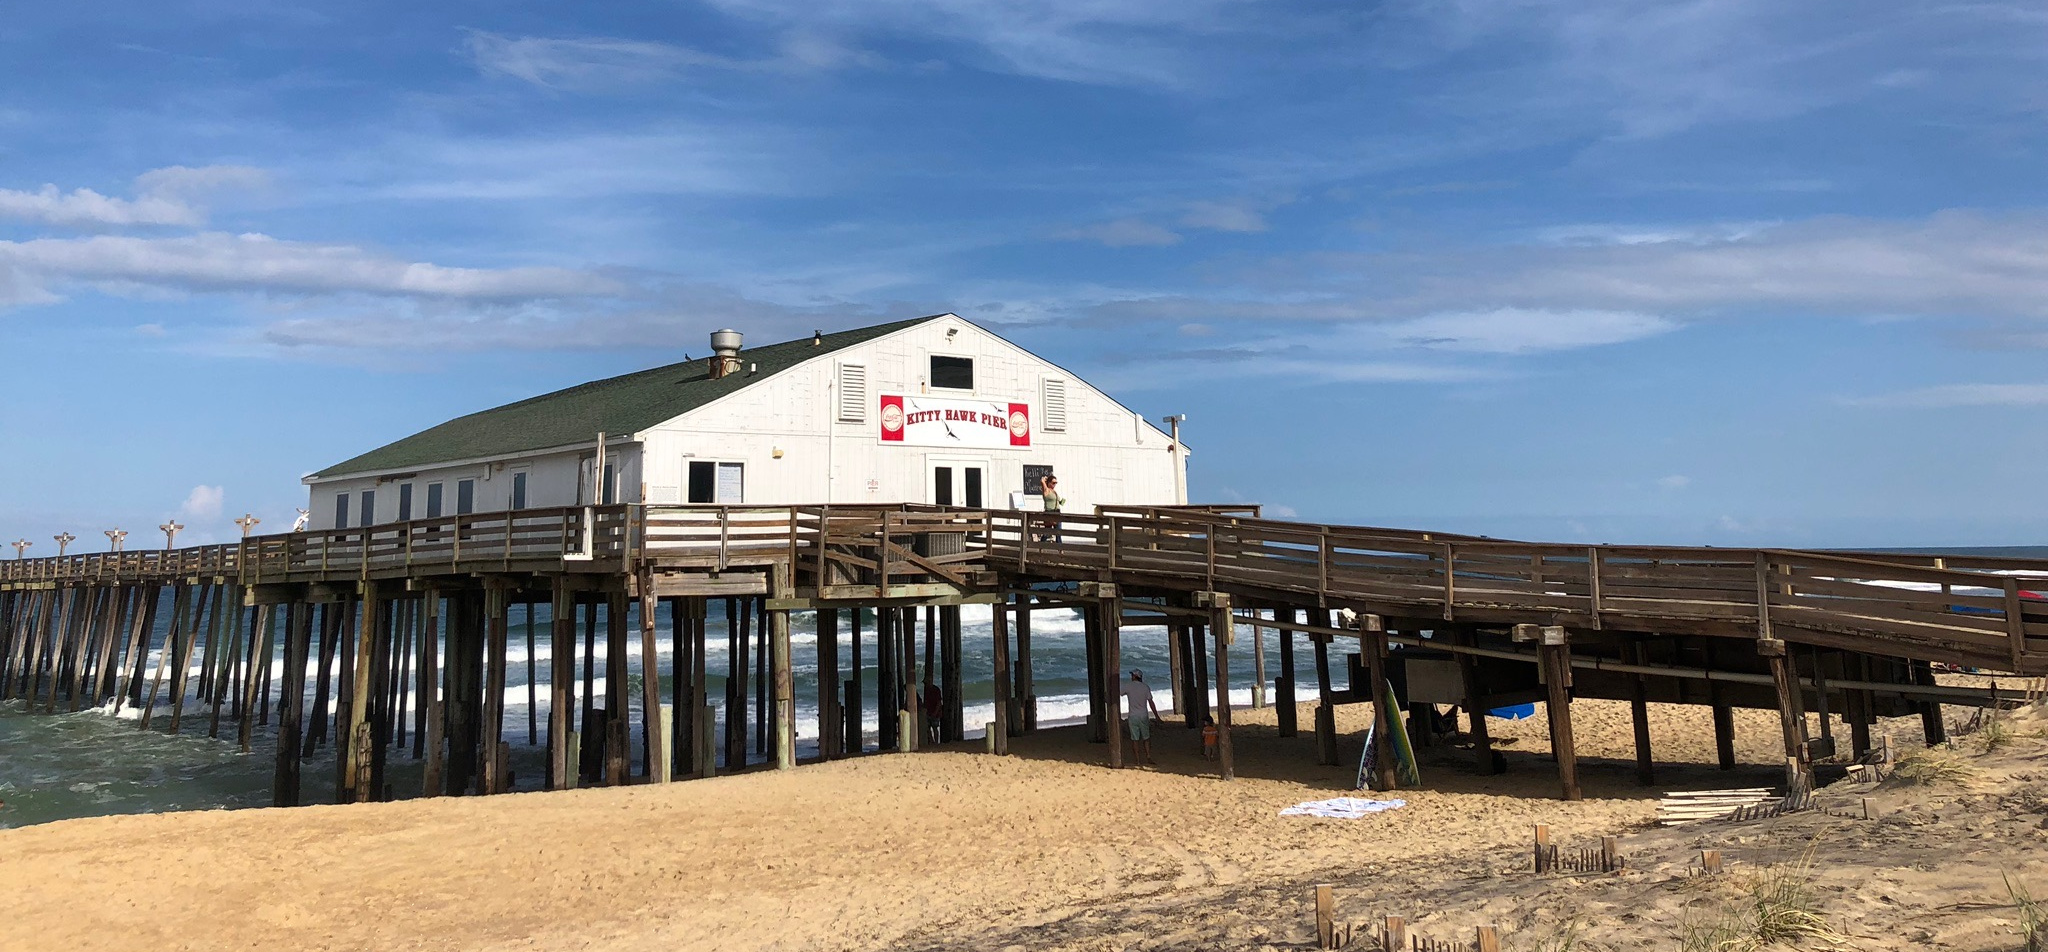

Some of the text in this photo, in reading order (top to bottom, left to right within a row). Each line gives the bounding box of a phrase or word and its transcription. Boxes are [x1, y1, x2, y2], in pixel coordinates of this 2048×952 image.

[906, 410, 941, 425] KITTY
[945, 409, 977, 423] HAWK
[981, 412, 1007, 430] PIER
